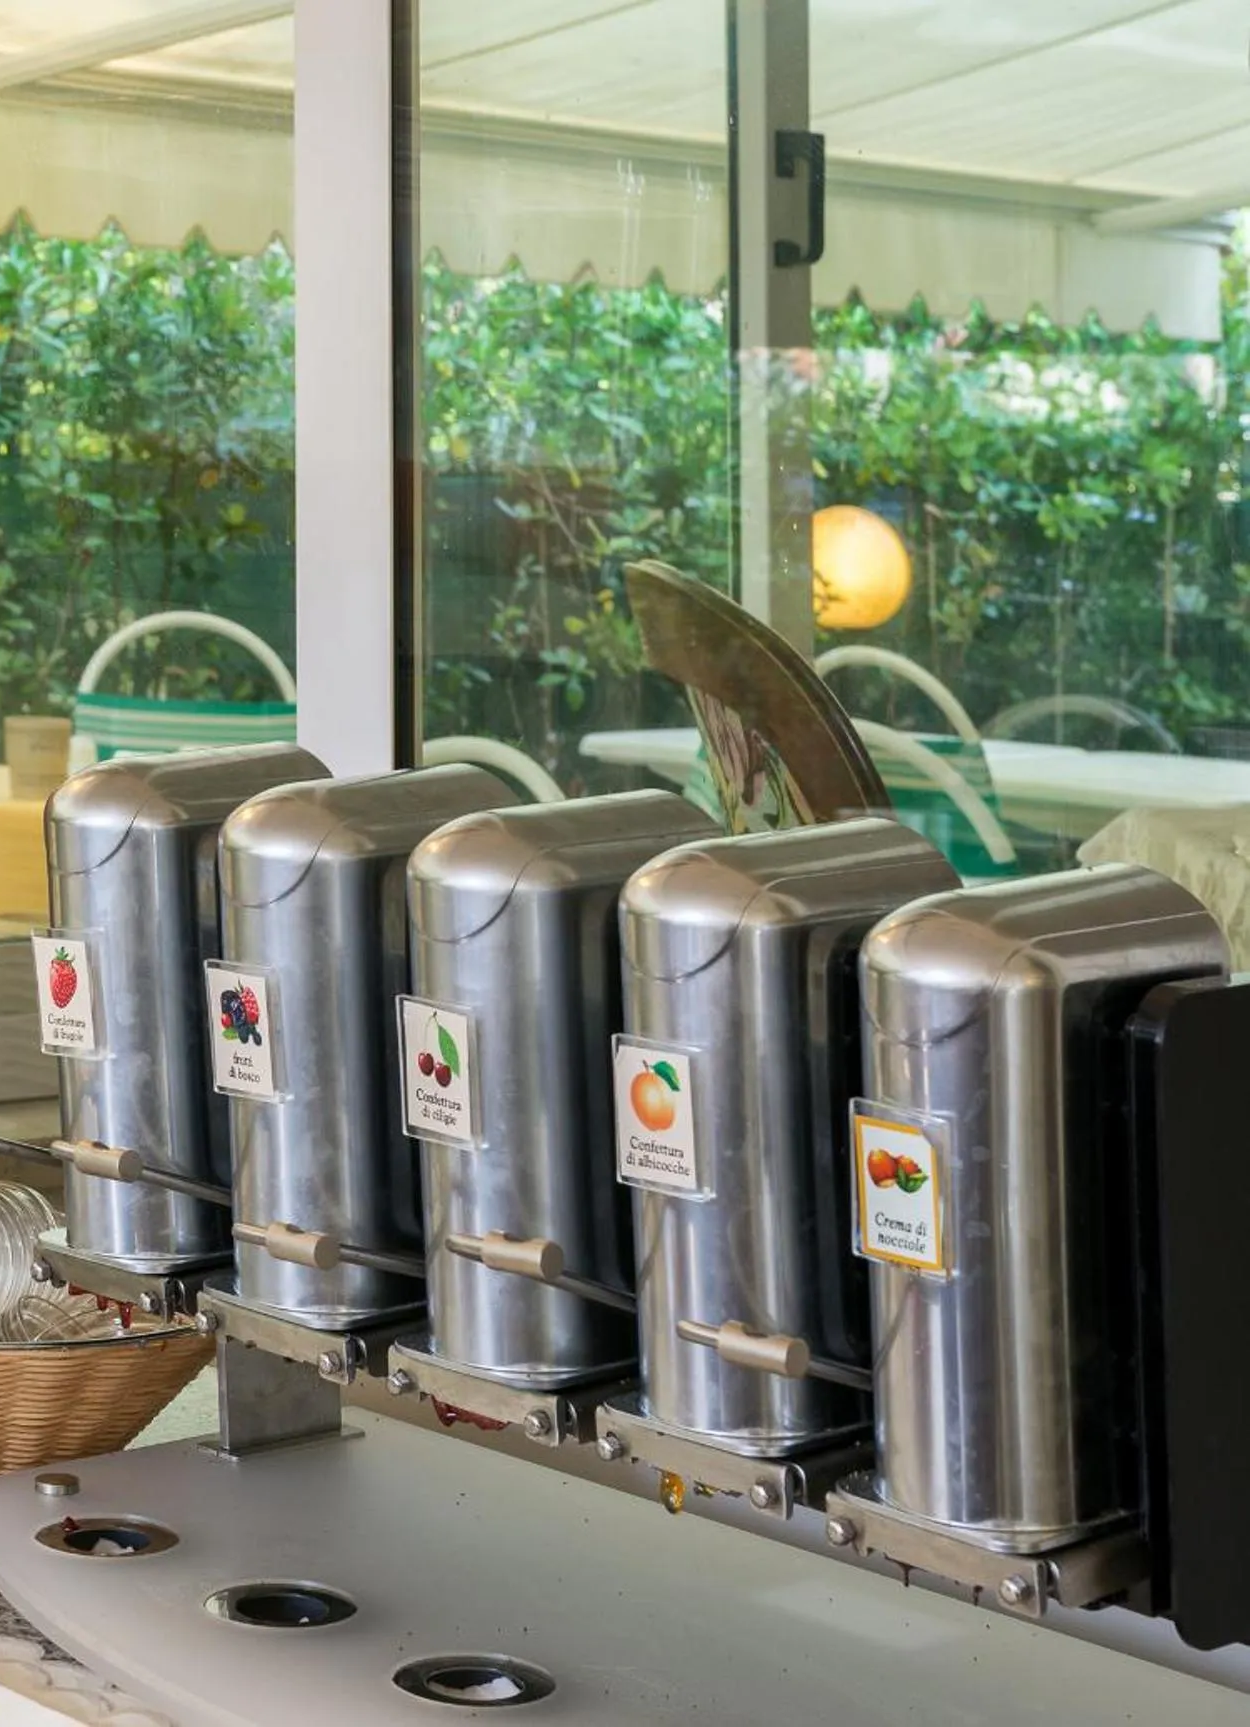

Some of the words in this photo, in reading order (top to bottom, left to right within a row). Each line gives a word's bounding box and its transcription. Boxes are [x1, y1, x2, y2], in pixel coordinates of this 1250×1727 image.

[229, 1066, 236, 1079] di
[238, 1067, 261, 1083] bosco
[416, 1087, 462, 1111] Confettura
[421, 1105, 431, 1119] di
[630, 1135, 684, 1159] Confettura
[626, 1151, 636, 1166] di
[638, 1154, 691, 1176] albicocche
[874, 1211, 912, 1233] Crema
[915, 1221, 927, 1237] di
[877, 1232, 927, 1253] nocciole
